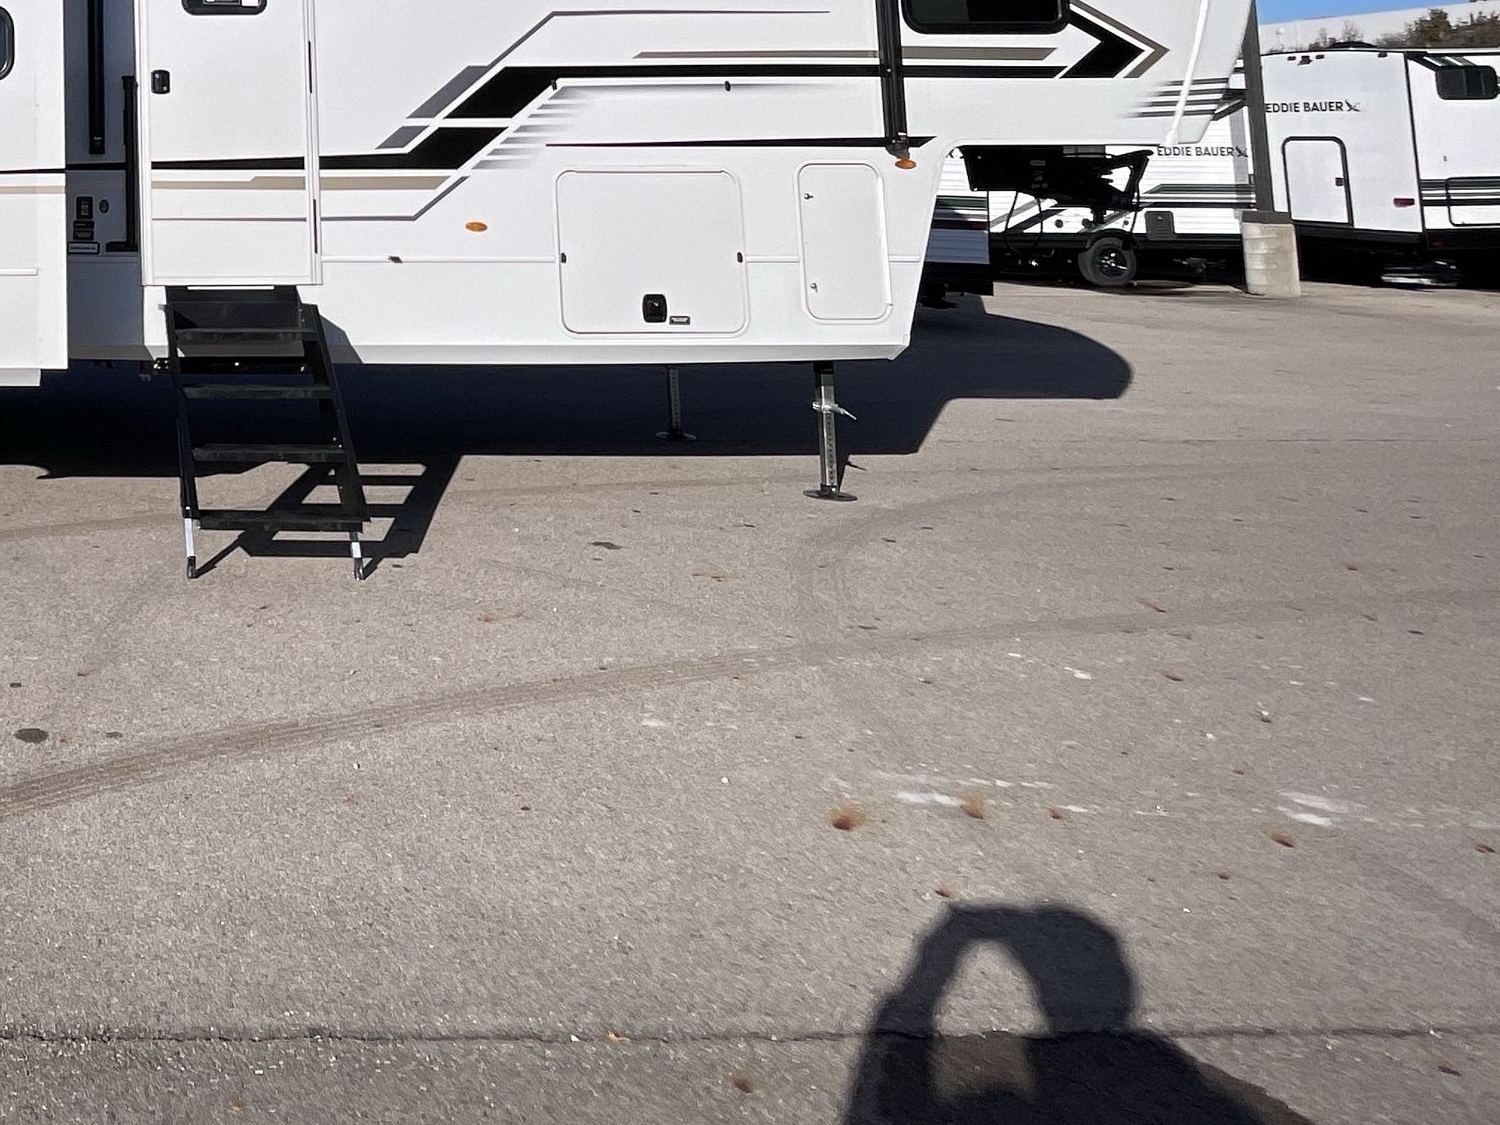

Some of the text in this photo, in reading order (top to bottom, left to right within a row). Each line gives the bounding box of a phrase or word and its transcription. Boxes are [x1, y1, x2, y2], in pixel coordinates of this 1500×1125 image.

[1265, 101, 1344, 113] EDDIE BAUER
[1157, 146, 1235, 157] EDDIE BAUER
